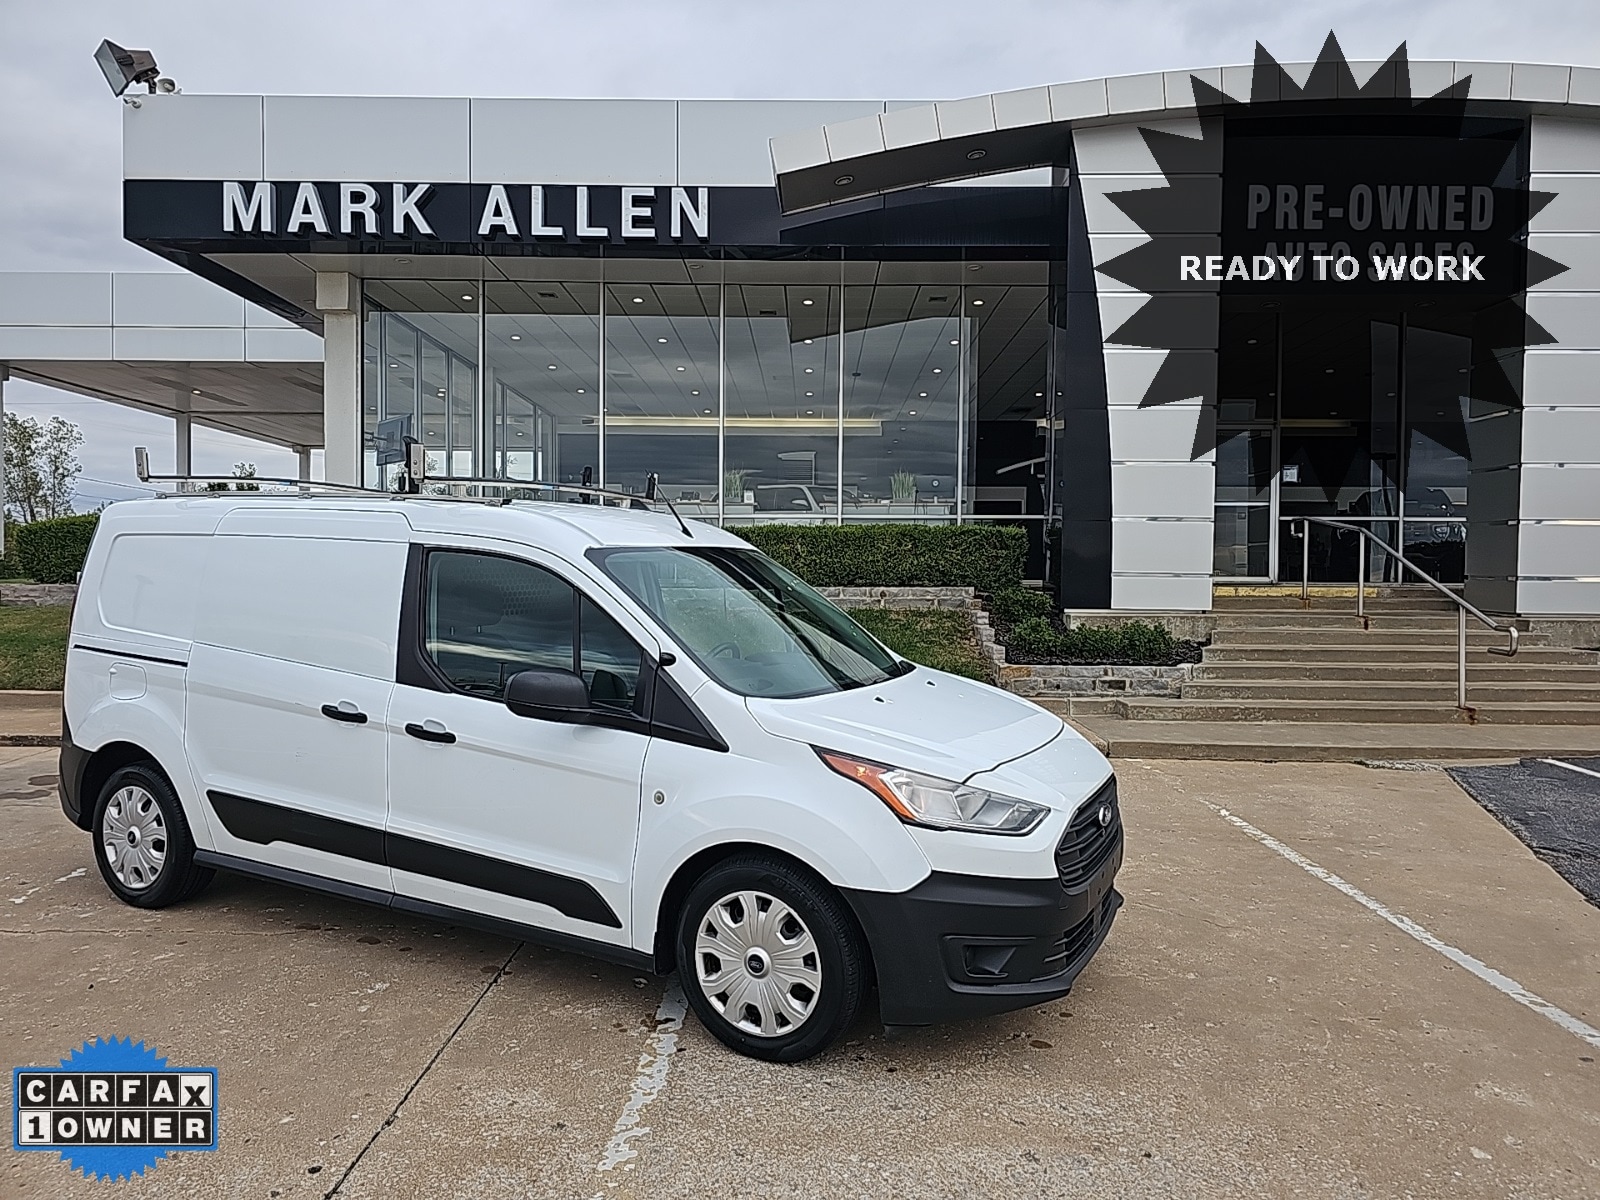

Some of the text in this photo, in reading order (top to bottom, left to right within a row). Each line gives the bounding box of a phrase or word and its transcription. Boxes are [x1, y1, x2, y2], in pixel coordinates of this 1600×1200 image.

[222, 181, 709, 239] MARK ALLEN
[1246, 184, 1494, 231] PRE-OWNED
